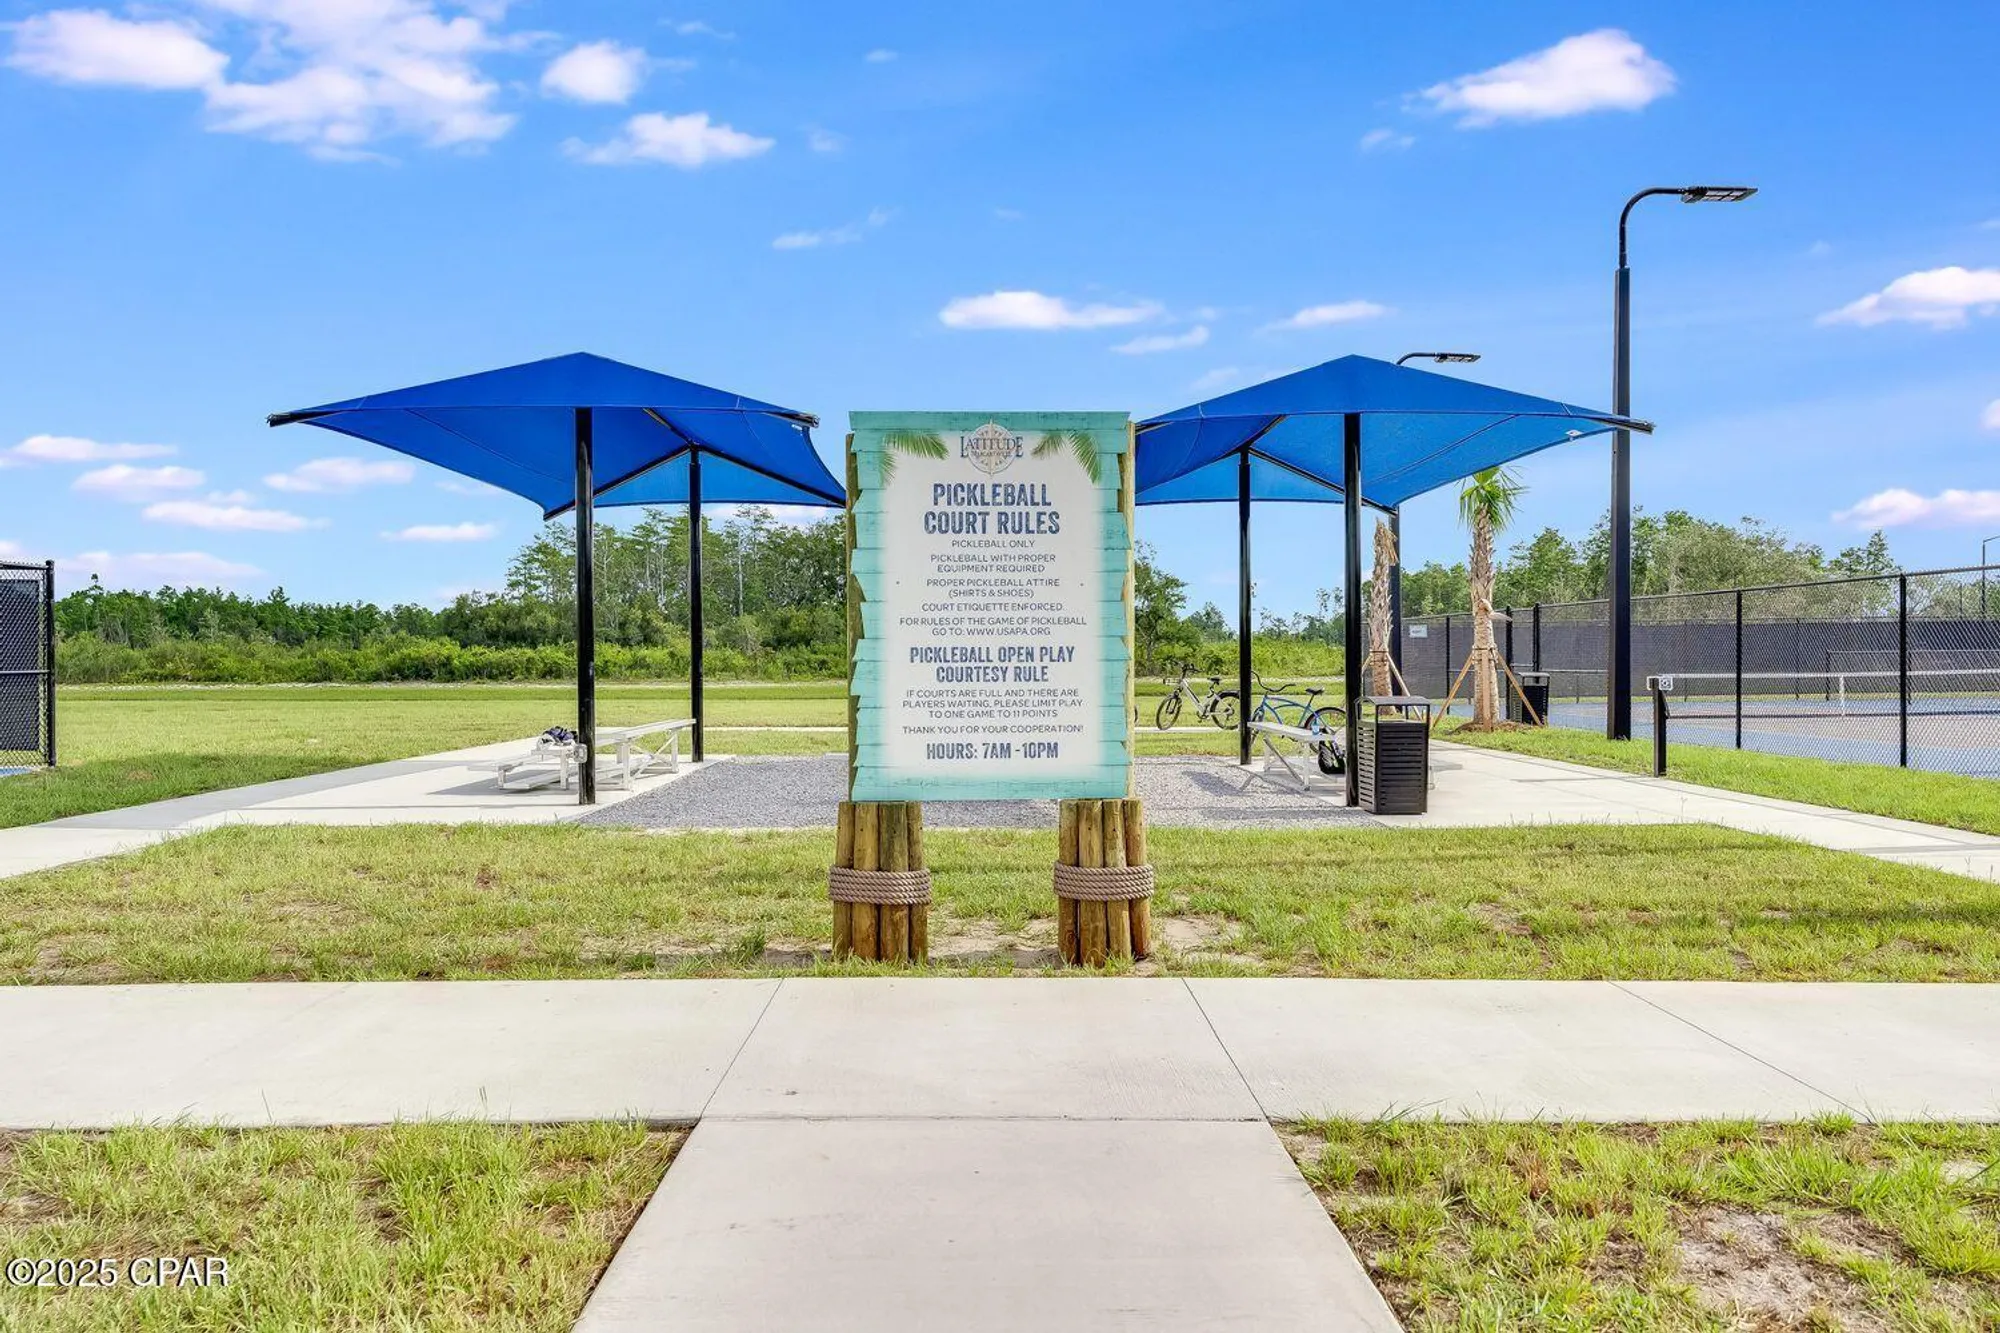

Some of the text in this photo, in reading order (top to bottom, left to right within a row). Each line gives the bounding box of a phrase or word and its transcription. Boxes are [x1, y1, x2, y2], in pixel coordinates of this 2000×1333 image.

[960, 436, 1024, 458] LATITUDE
[933, 483, 1052, 506] PICKLEBALL
[924, 511, 1060, 534] COURT RULES
[951, 539, 1035, 548] PICKLEBALL ONLY
[930, 554, 1056, 562] PICKLEBALL WITH PROPER
[937, 564, 1045, 573] EQUIPMENT REQUIRED
[926, 579, 1060, 587] PROPER PICKLEBALL ATTIRE
[948, 588, 1035, 599] (SHIRTS & SHOES)
[922, 603, 955, 611] COURT
[957, 603, 1009, 611] ETIQUETTE
[900, 616, 1087, 626] FOR RULES OF THE GAME OF PICKLEBALL
[932, 627, 947, 635] GO
[966, 627, 1051, 636] WWW.USAPA.ORG
[910, 646, 1075, 663] PICKLEBALL OPEN PLAY
[936, 665, 1049, 682] COURTESY RULE
[906, 688, 1079, 698] IF COURTS ARE FULL AND THERE ARE
[902, 700, 945, 708] PLAYERS
[994, 699, 1029, 708] PLEASE
[1032, 699, 1057, 708] LIMIT
[1059, 699, 1083, 707] PLAY
[929, 709, 1058, 718] TO ONE GAME TO 11 POINTS
[902, 724, 1084, 734] THANK YOU FOR YOUR COOPERATION!
[926, 742, 977, 760] HOURS:
[982, 742, 1011, 759] 7AM
